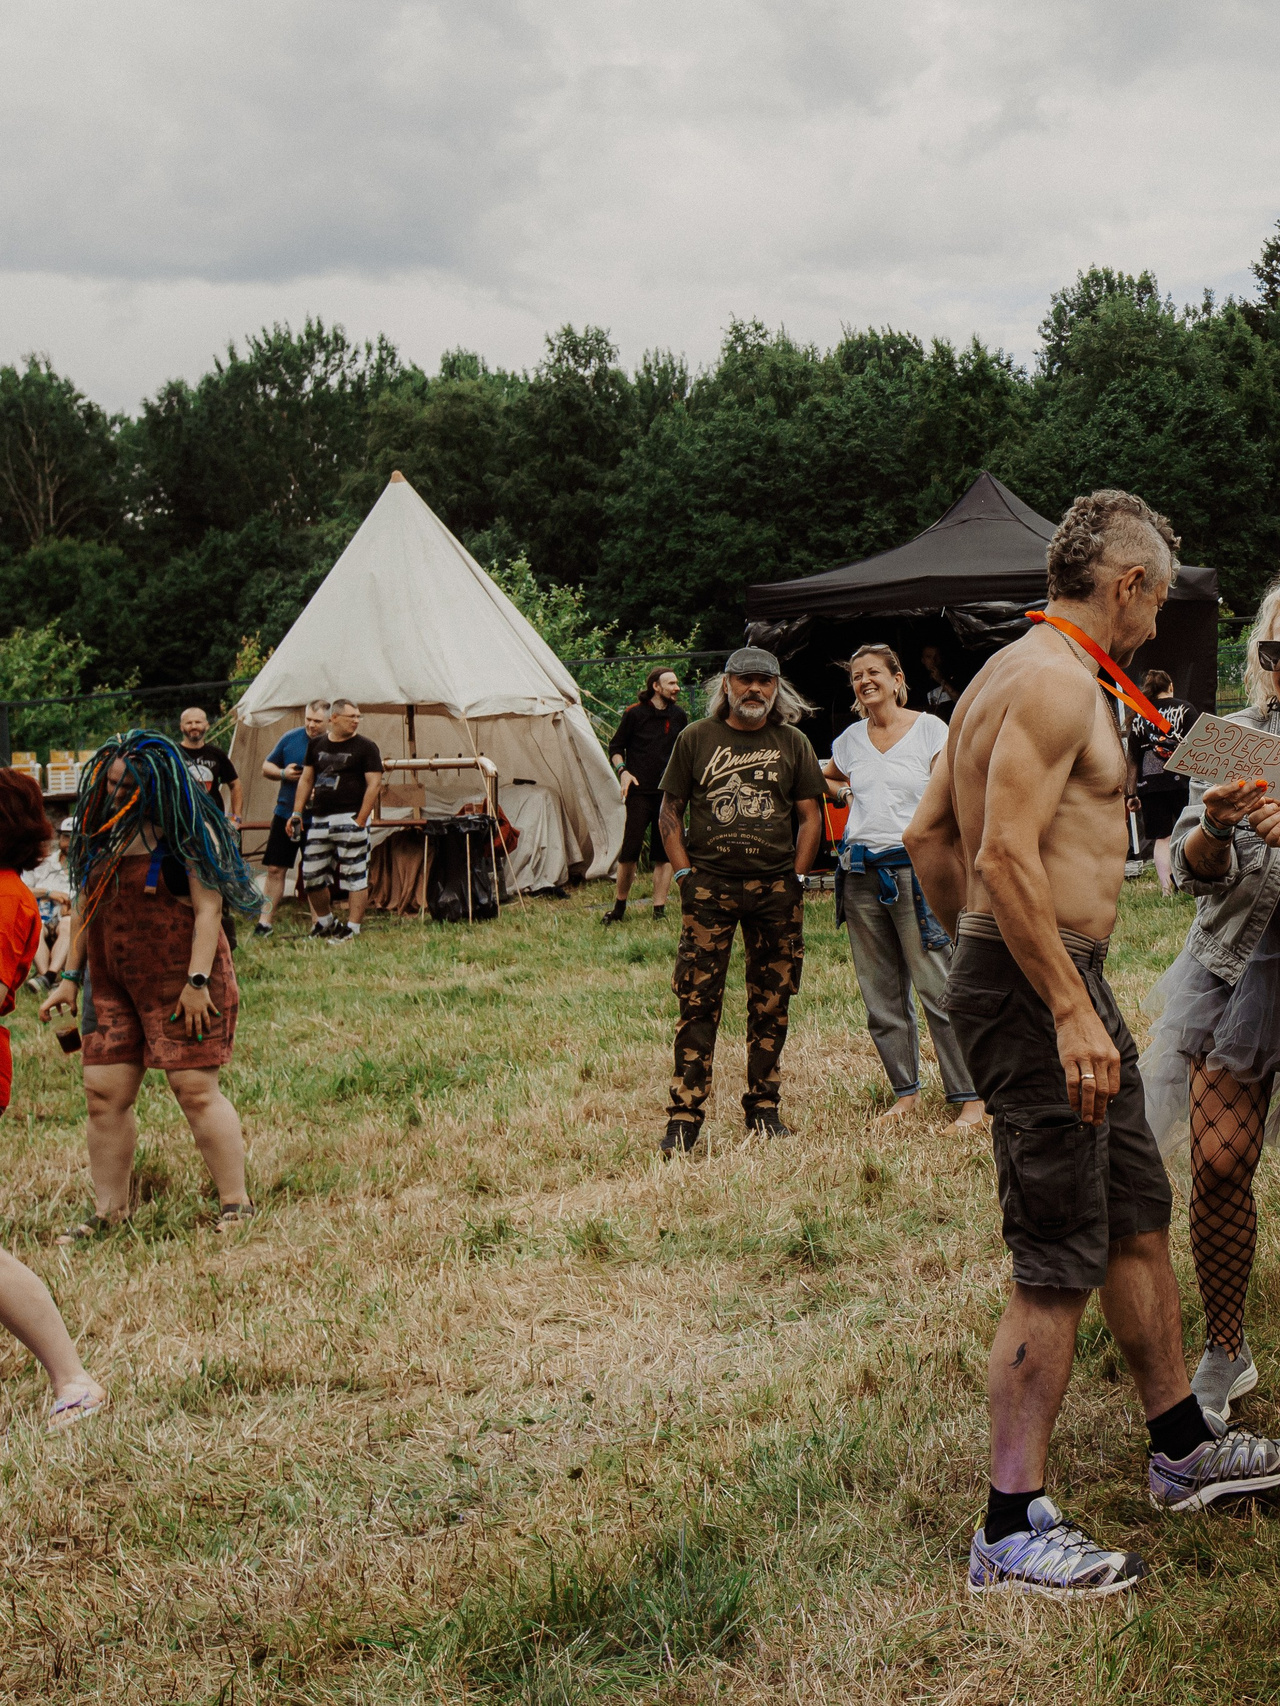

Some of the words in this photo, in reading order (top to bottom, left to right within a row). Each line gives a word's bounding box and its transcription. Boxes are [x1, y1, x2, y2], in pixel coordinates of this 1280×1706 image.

[700, 745, 781, 785] Юпитер
[1182, 748, 1230, 770] МОГЛА
[1174, 760, 1218, 779] ВАША
[1223, 770, 1276, 794] РЕКА
